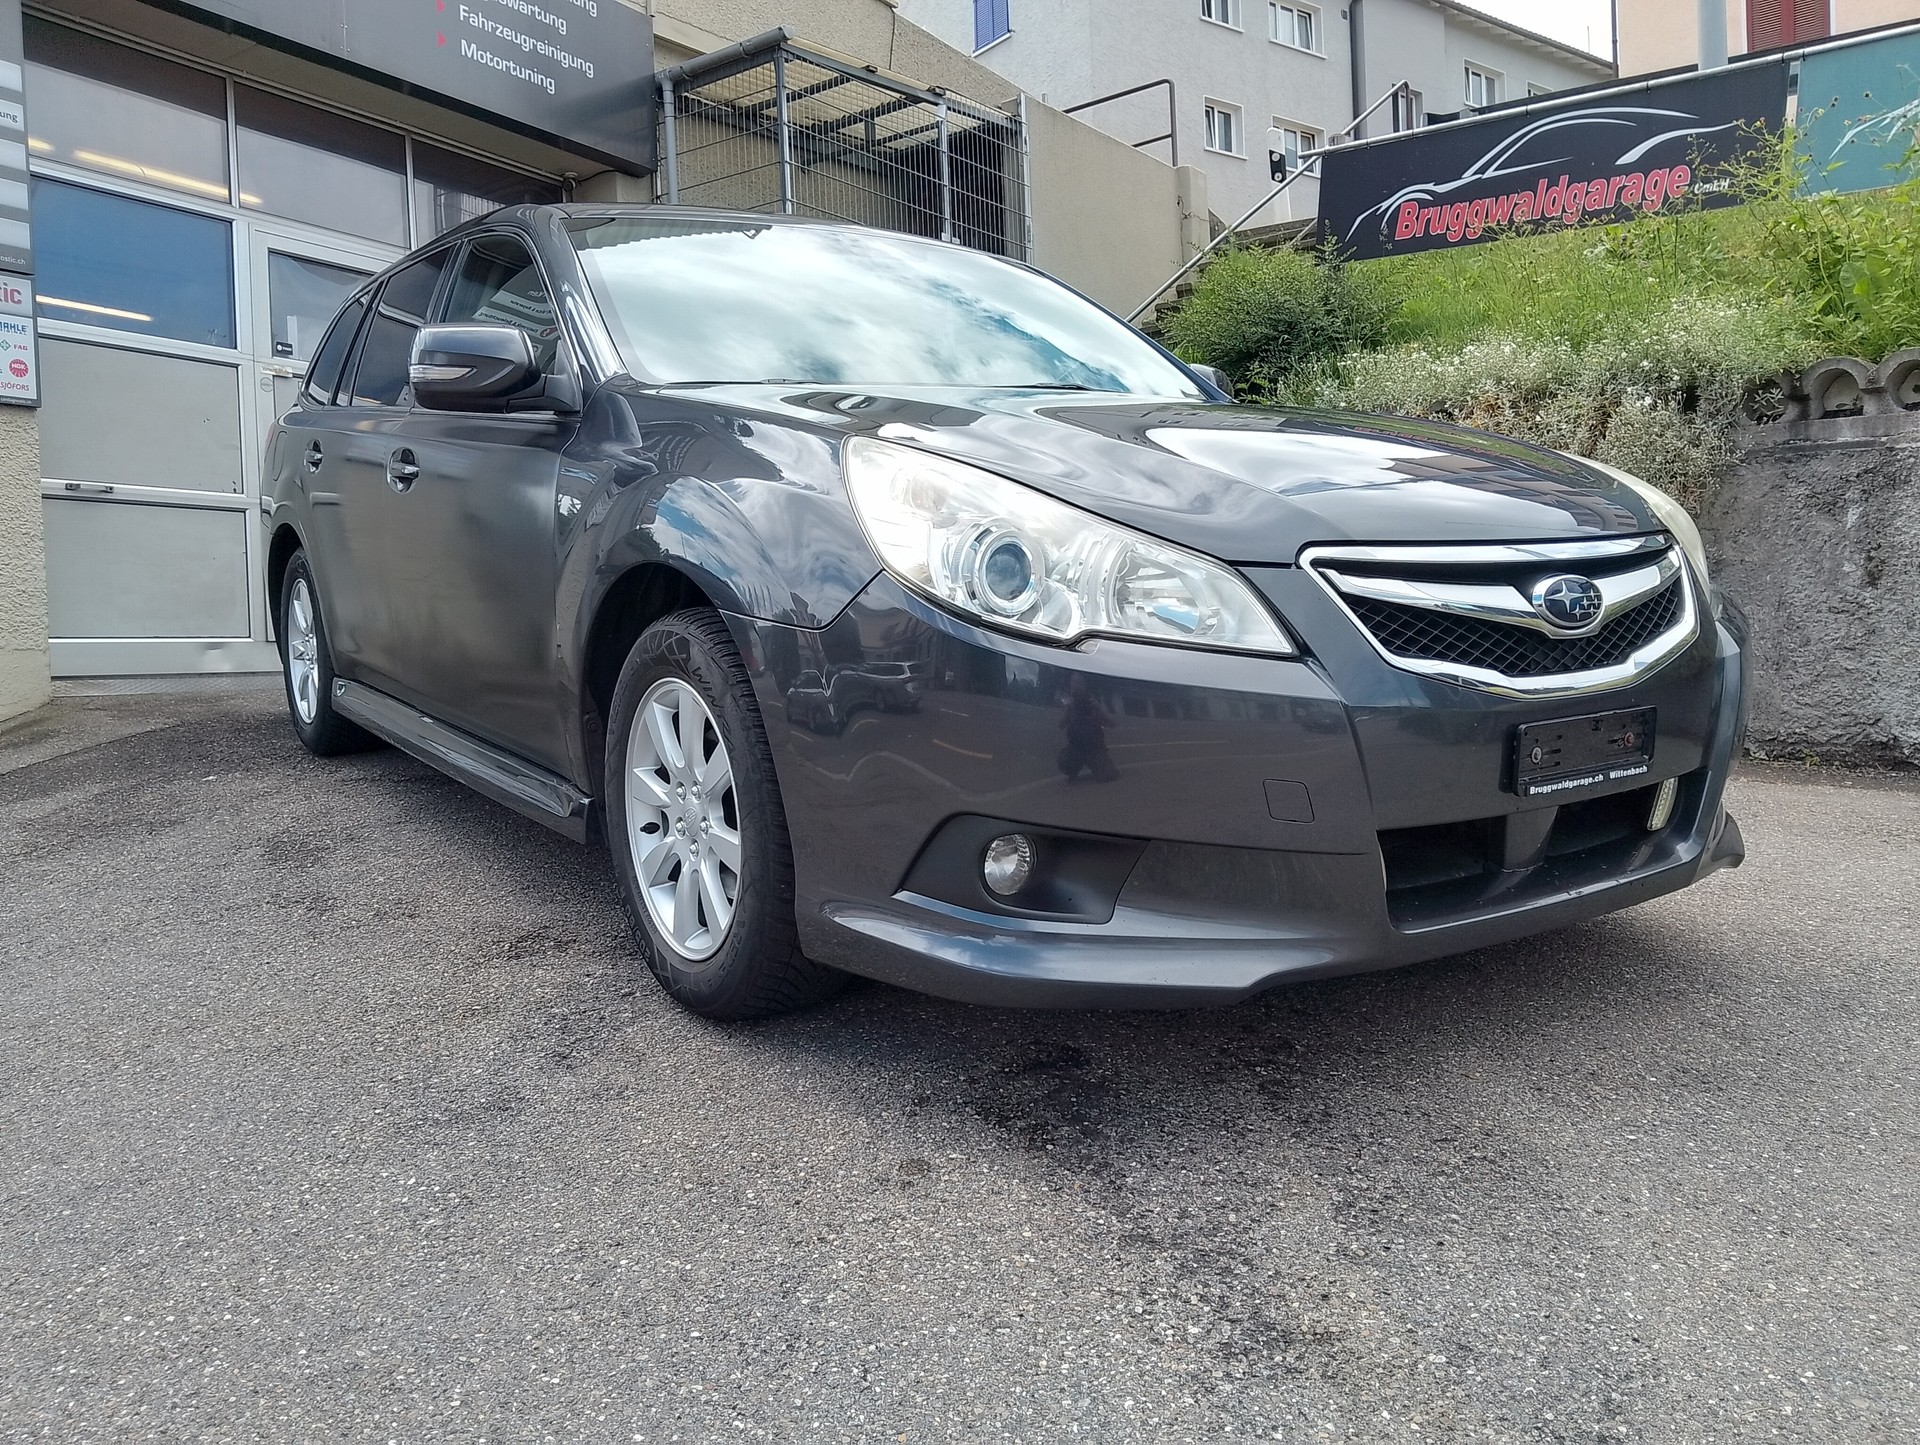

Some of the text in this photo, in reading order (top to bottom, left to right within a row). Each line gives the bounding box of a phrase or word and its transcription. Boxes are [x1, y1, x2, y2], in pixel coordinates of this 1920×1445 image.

[459, 4, 595, 79] Fahrzeugreinigung
[460, 38, 556, 95] Motortuning
[1394, 164, 1691, 243] Bruggwaldgarage
[0, 281, 23, 305] ic
[11, 362, 26, 371] NGK
[1529, 765, 1648, 795] Bruggwaldgarage.ch Wittenbach
